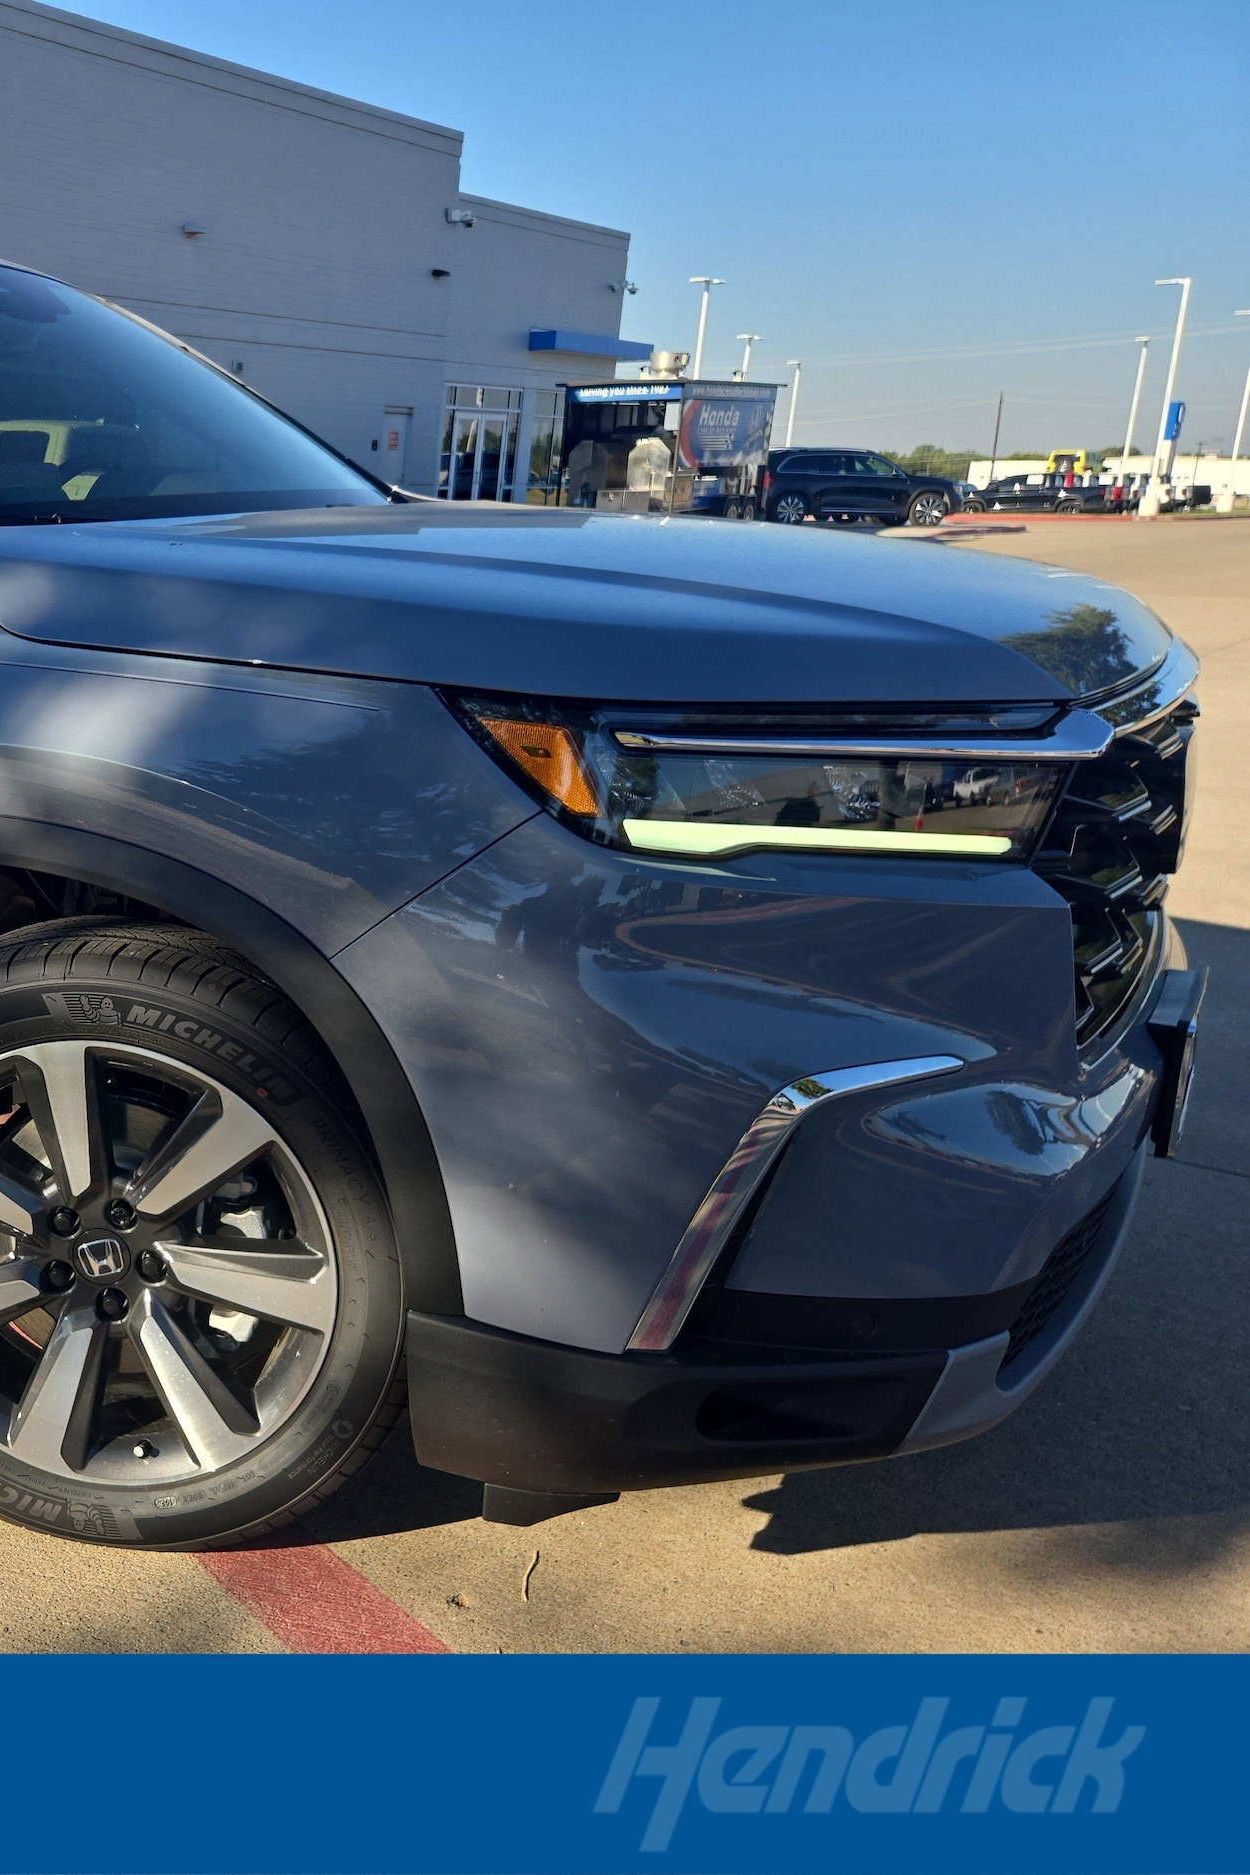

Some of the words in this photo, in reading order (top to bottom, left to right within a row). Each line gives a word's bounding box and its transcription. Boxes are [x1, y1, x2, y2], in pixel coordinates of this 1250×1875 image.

[699, 404, 740, 426] Honda
[126, 1004, 296, 1099] MICHELIN
[309, 1117, 371, 1206] PRIMACY
